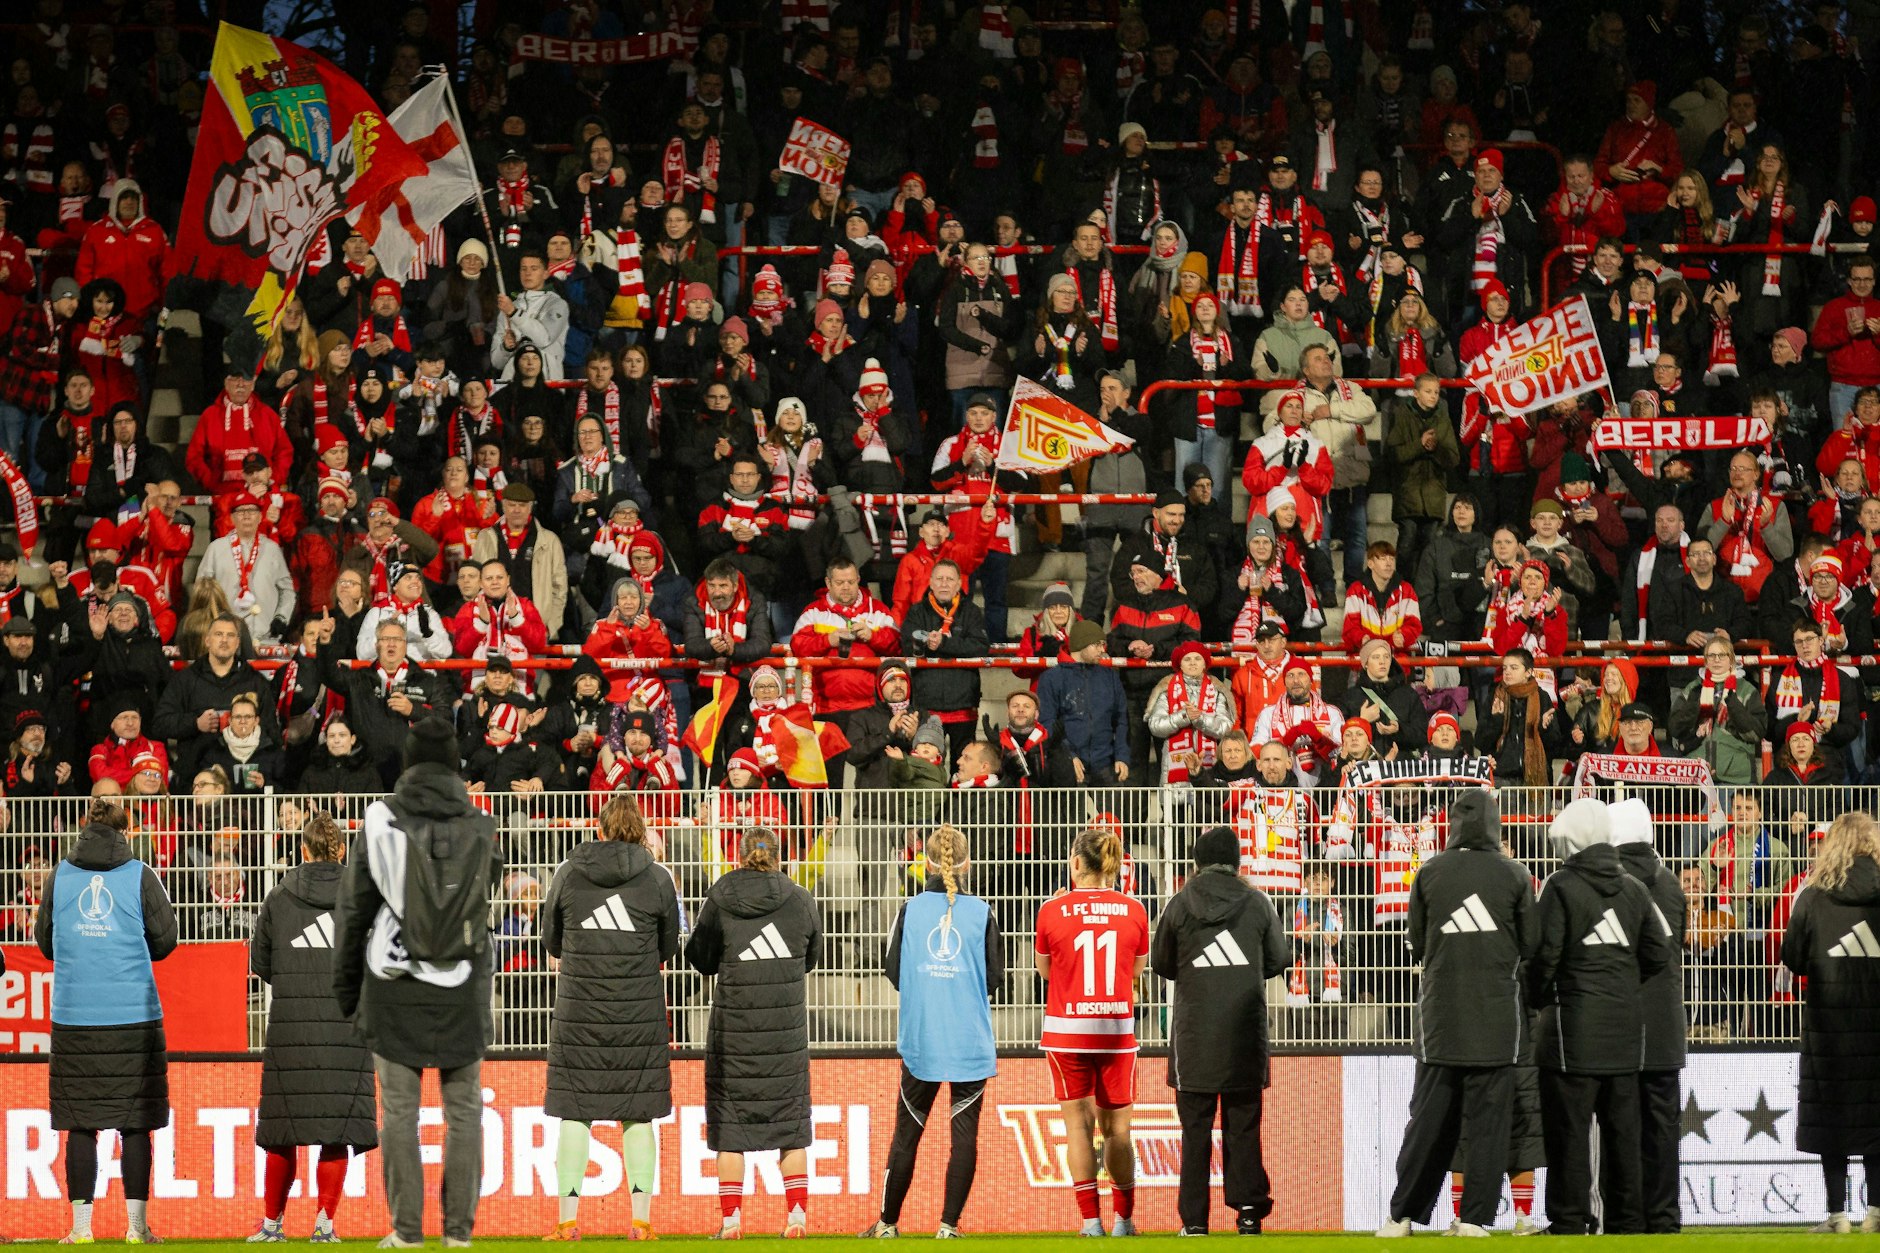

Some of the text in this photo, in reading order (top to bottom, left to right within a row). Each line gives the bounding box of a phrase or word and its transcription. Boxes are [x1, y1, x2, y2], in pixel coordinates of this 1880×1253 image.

[1347, 759, 1373, 788] FC
[1624, 762, 1652, 775] AN
[1073, 903, 1089, 916] FC
[1091, 903, 1129, 916] UNION
[1082, 915, 1109, 925] BERLIN
[1074, 930, 1118, 996] 11
[930, 971, 955, 979] FRAUEN
